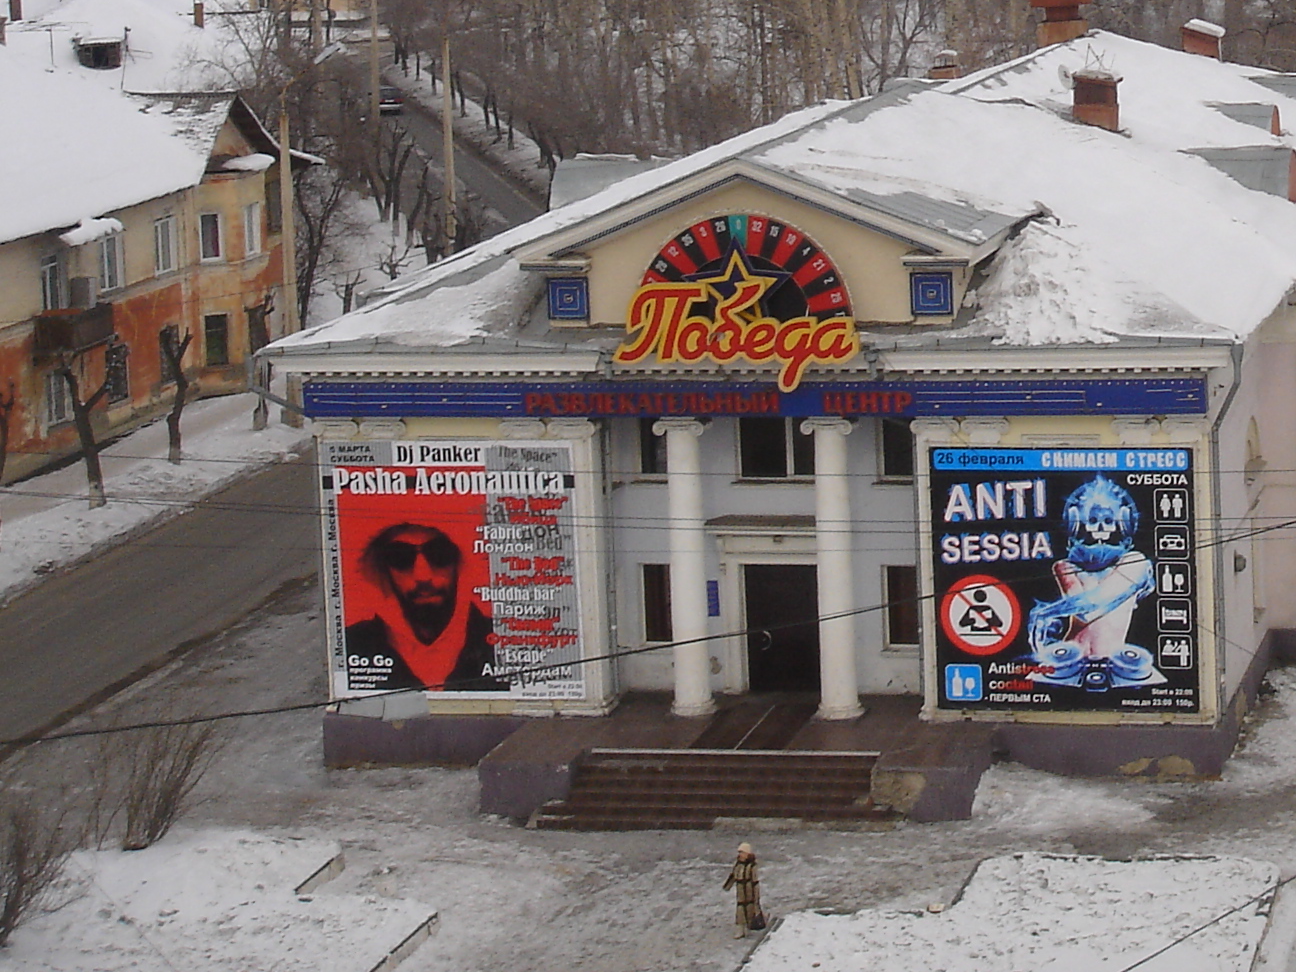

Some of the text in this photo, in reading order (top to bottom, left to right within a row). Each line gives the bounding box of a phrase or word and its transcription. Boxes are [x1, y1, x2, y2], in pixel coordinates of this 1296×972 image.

[614, 280, 859, 392] Победа
[524, 391, 913, 416] РАЗВЛЕКАТЕЛЬНЫЙ ЦЕНТР
[338, 445, 371, 453] МАРТА
[396, 445, 481, 464] Dj Panker
[330, 455, 375, 463] СУББОТА
[937, 453, 1024, 466] 26 февраля
[1041, 452, 1187, 468] СНИМАЕМ СТРЕСС
[332, 467, 565, 495] Pasha Aeronautica
[1126, 474, 1188, 485] СУББОТА
[943, 479, 1047, 522] ANTI
[328, 499, 338, 541] Москва
[473, 540, 534, 554] Лондон
[940, 532, 1054, 565] SESSIA
[331, 556, 340, 598] Москва
[494, 602, 547, 617] Париж
[334, 615, 343, 657] Москва
[348, 655, 393, 667] Go Go
[1032, 694, 1051, 702] СТА
